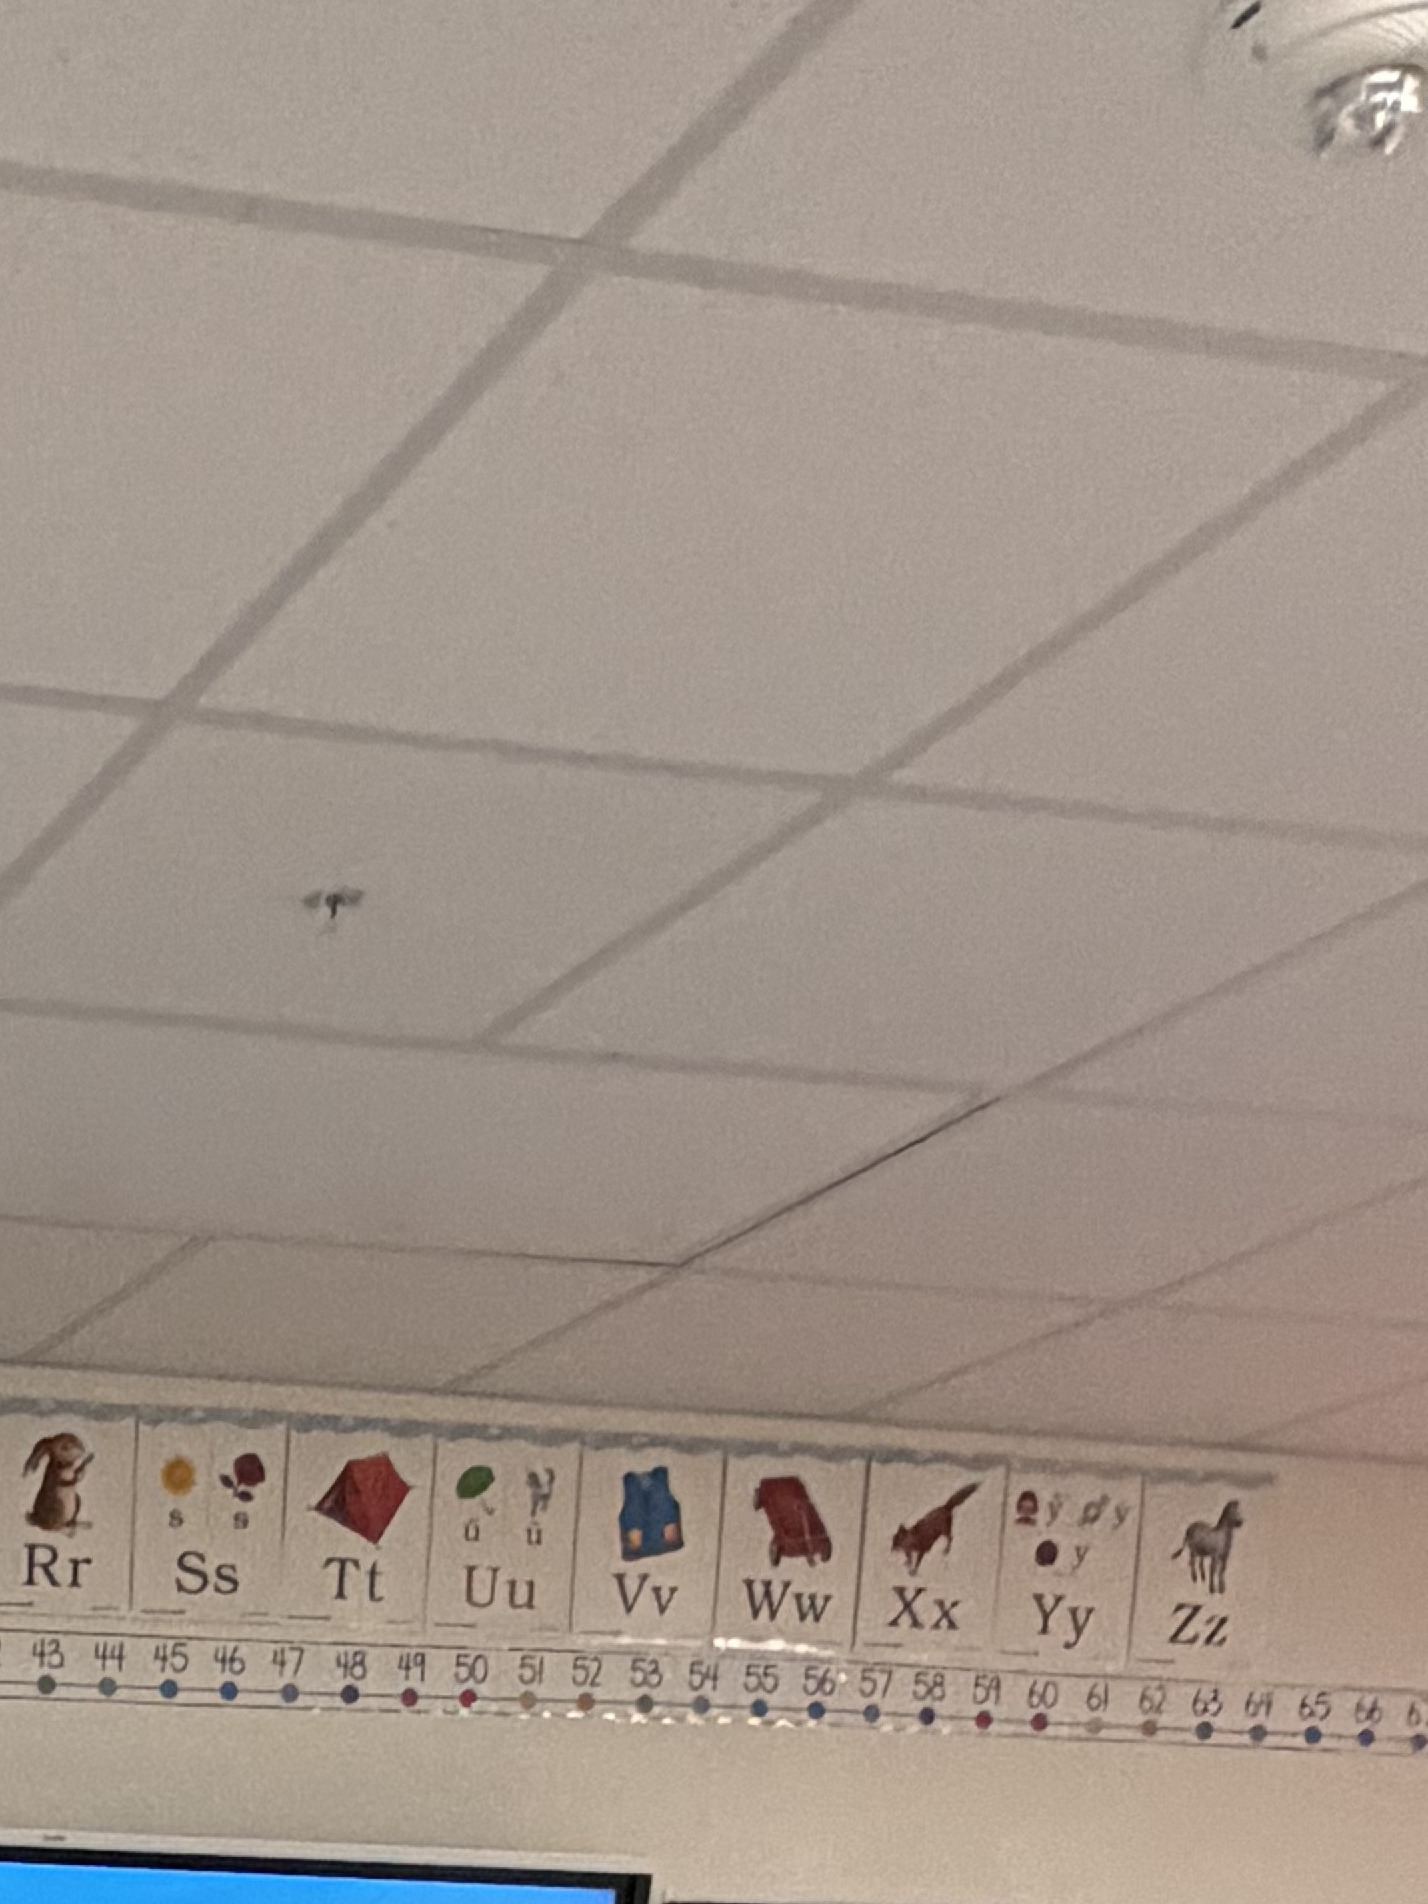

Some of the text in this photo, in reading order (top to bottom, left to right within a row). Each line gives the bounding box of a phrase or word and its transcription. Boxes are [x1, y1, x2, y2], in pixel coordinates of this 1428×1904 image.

[23, 1543, 92, 1589] Rr
[175, 1551, 239, 1594] Ss
[322, 1557, 385, 1601] Tt
[464, 1566, 537, 1609] Uu
[613, 1573, 678, 1615] Vv
[743, 1578, 834, 1622] Ww
[888, 1586, 960, 1630] Xx
[1033, 1594, 1095, 1646] Yy
[1169, 1605, 1228, 1646] Zz
[32, 1638, 64, 1667] 43
[94, 1642, 126, 1670] 44
[153, 1643, 189, 1672] 45
[213, 1646, 245, 1673] 46
[273, 1648, 304, 1676] 47
[335, 1650, 367, 1678] 48
[397, 1653, 426, 1682] 49
[455, 1654, 488, 1683] 50
[518, 1659, 545, 1686] 51
[572, 1660, 603, 1686] 52
[629, 1661, 663, 1689] 53
[687, 1663, 720, 1689] 54
[744, 1663, 779, 1692] 55
[804, 1666, 837, 1694] 56
[861, 1668, 894, 1697] 57
[912, 1672, 946, 1701] 58
[972, 1674, 1001, 1703] 59
[1029, 1679, 1060, 1707] 60
